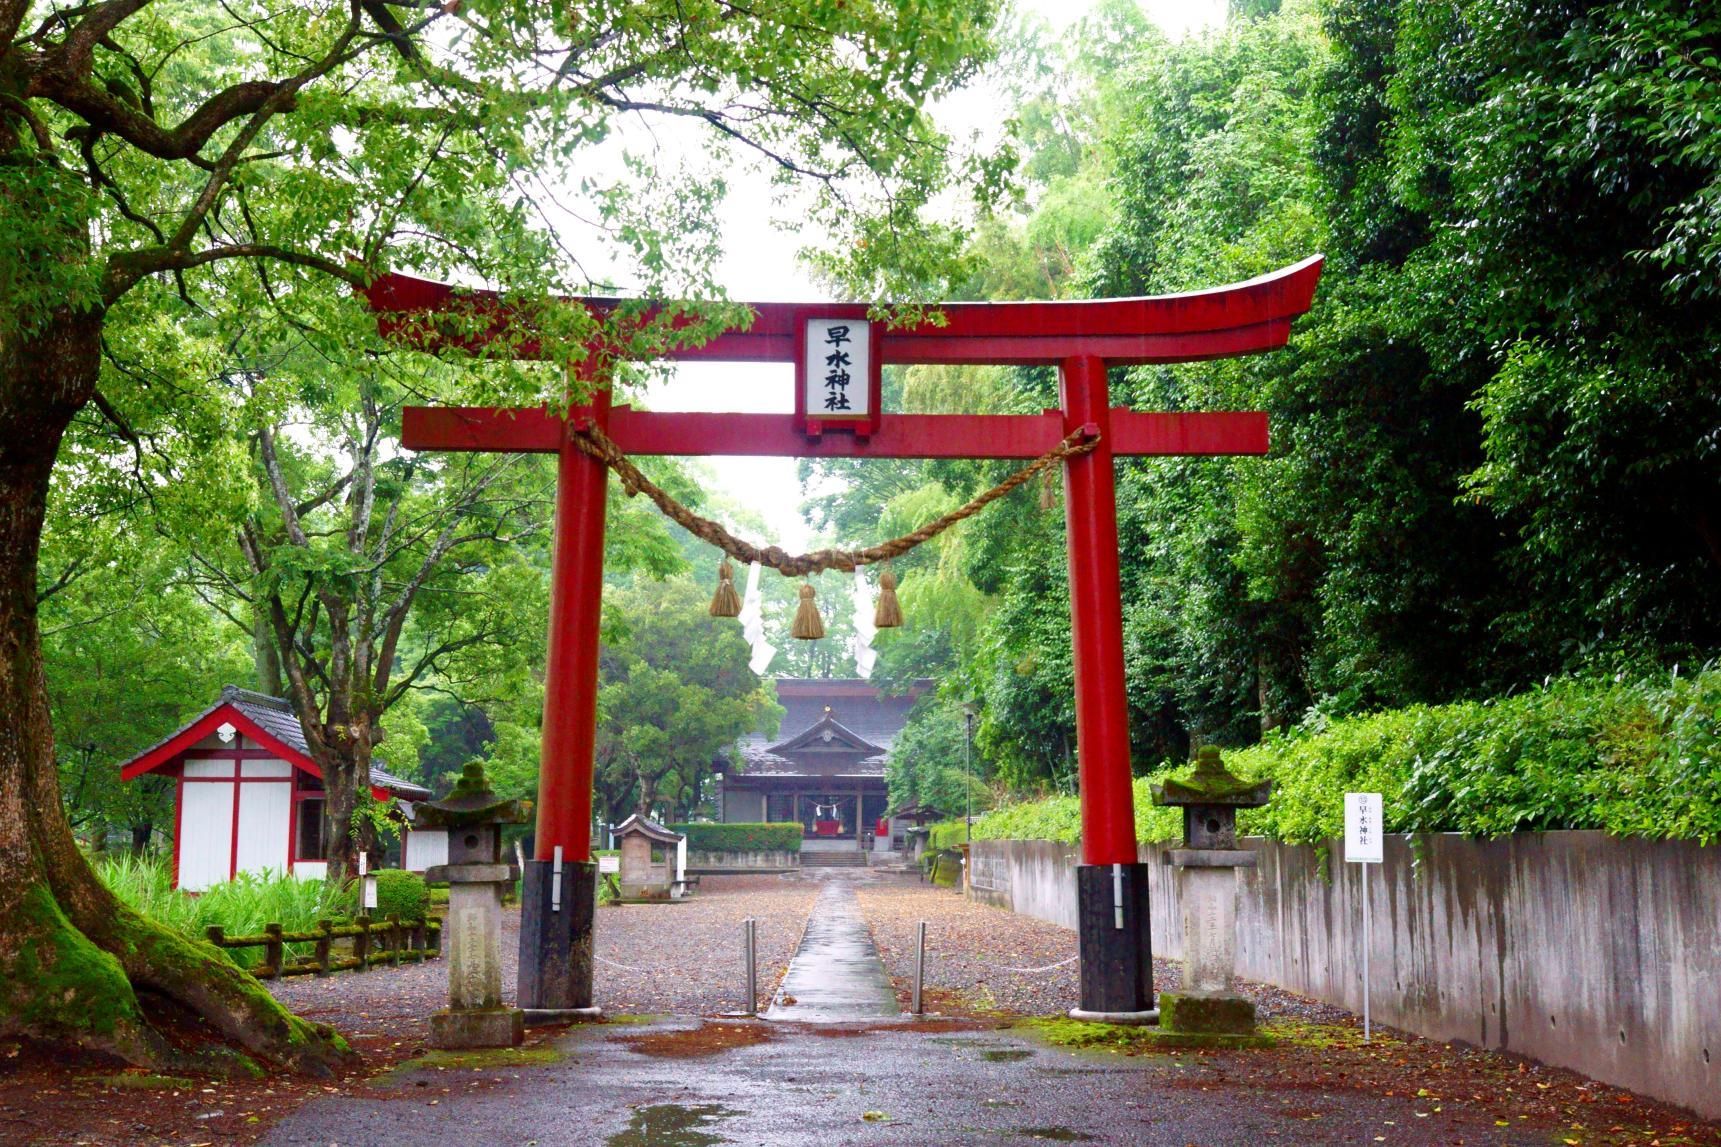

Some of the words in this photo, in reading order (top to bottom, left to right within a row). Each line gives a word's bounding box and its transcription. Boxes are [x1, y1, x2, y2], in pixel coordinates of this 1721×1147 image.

[824, 325, 852, 411] 早水神社
[1359, 805, 1368, 845] 早水神社
